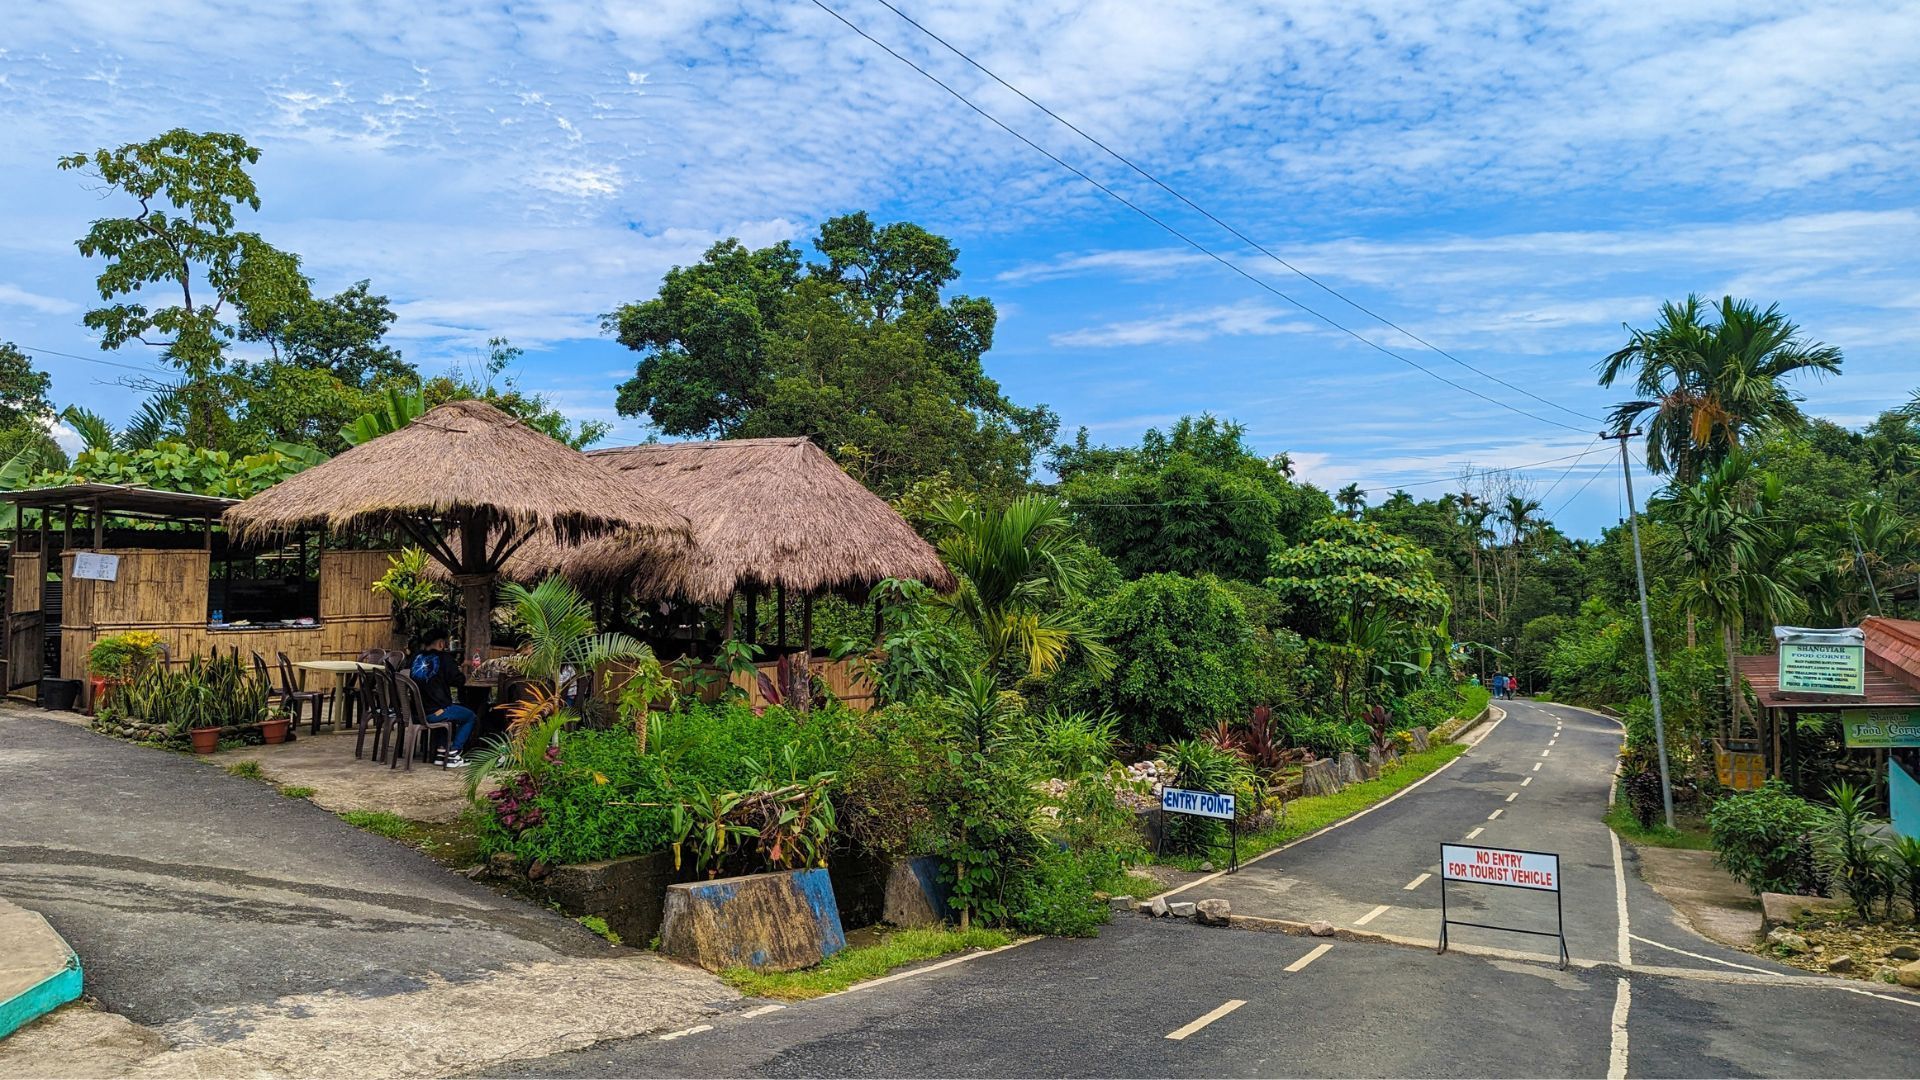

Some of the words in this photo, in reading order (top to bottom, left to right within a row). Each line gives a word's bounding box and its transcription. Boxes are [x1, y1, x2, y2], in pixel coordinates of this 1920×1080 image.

[1852, 723, 1883, 737] Food
[1166, 791, 1199, 811] ENTRY
[1476, 850, 1490, 865] NO
[1492, 852, 1523, 869] ENTRY
[1449, 862, 1467, 877] FOR
[1469, 864, 1509, 882] TOURIST
[1511, 869, 1553, 887] VEHICLE
